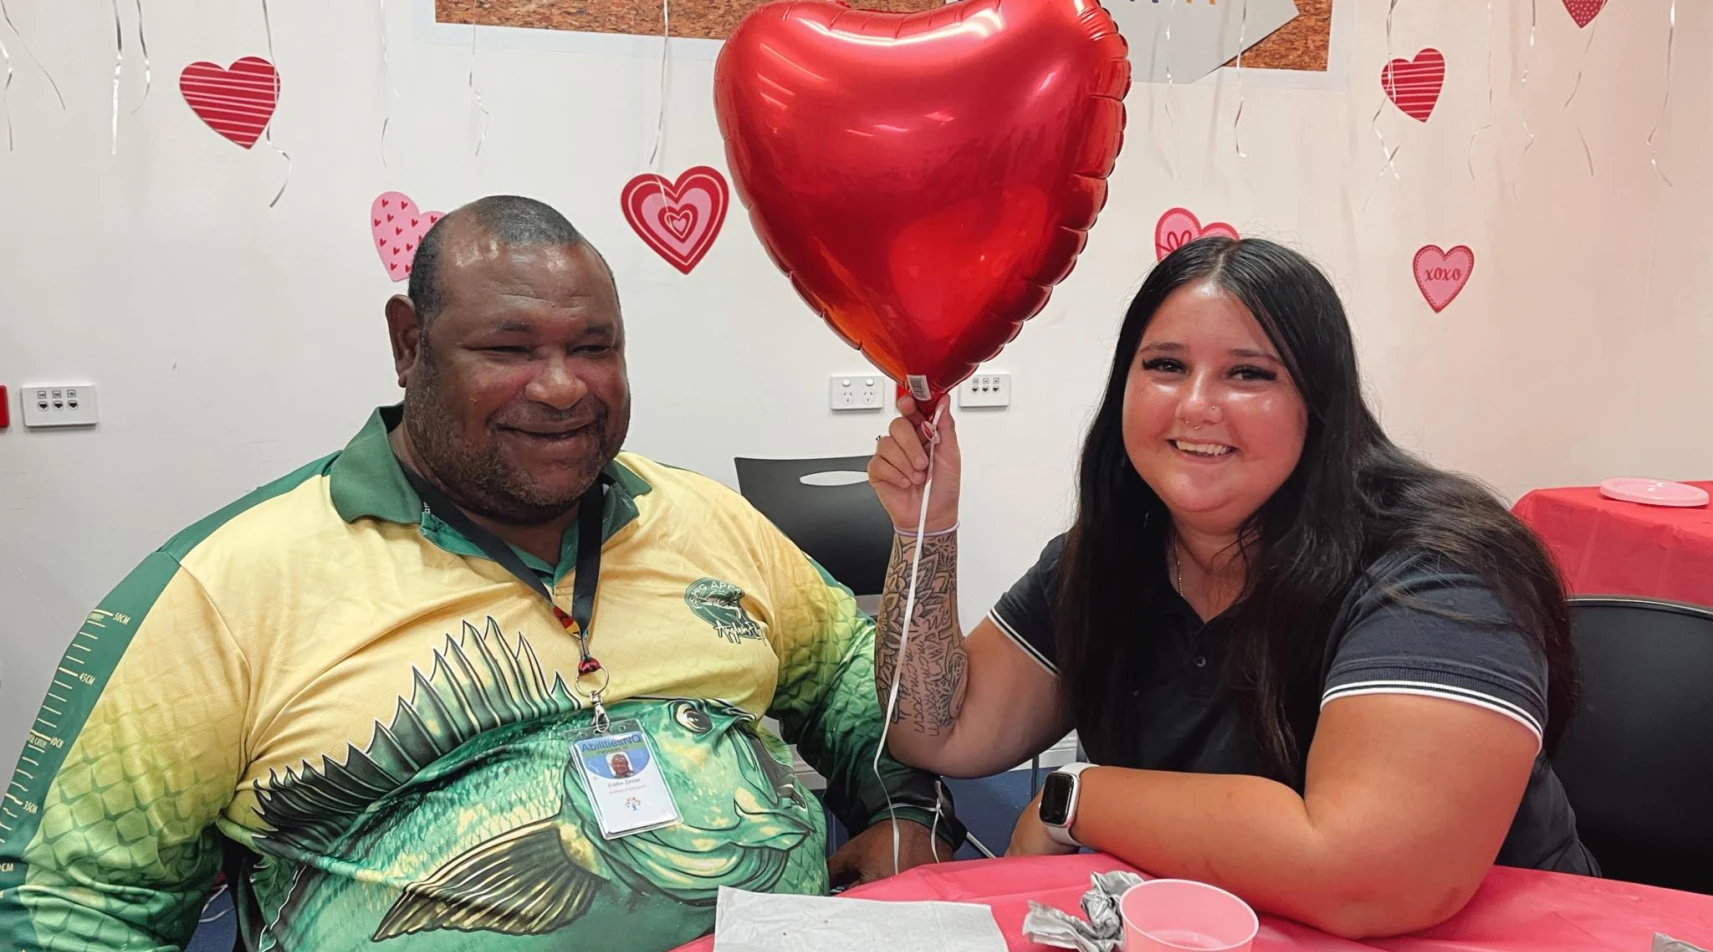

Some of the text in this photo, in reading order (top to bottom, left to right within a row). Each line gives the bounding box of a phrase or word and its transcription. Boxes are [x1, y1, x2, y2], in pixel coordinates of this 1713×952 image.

[1425, 267, 1462, 282] xoxo
[78, 672, 96, 686] 45CM
[582, 734, 641, 753] AbilitiesNQ
[23, 801, 38, 814] 35CM
